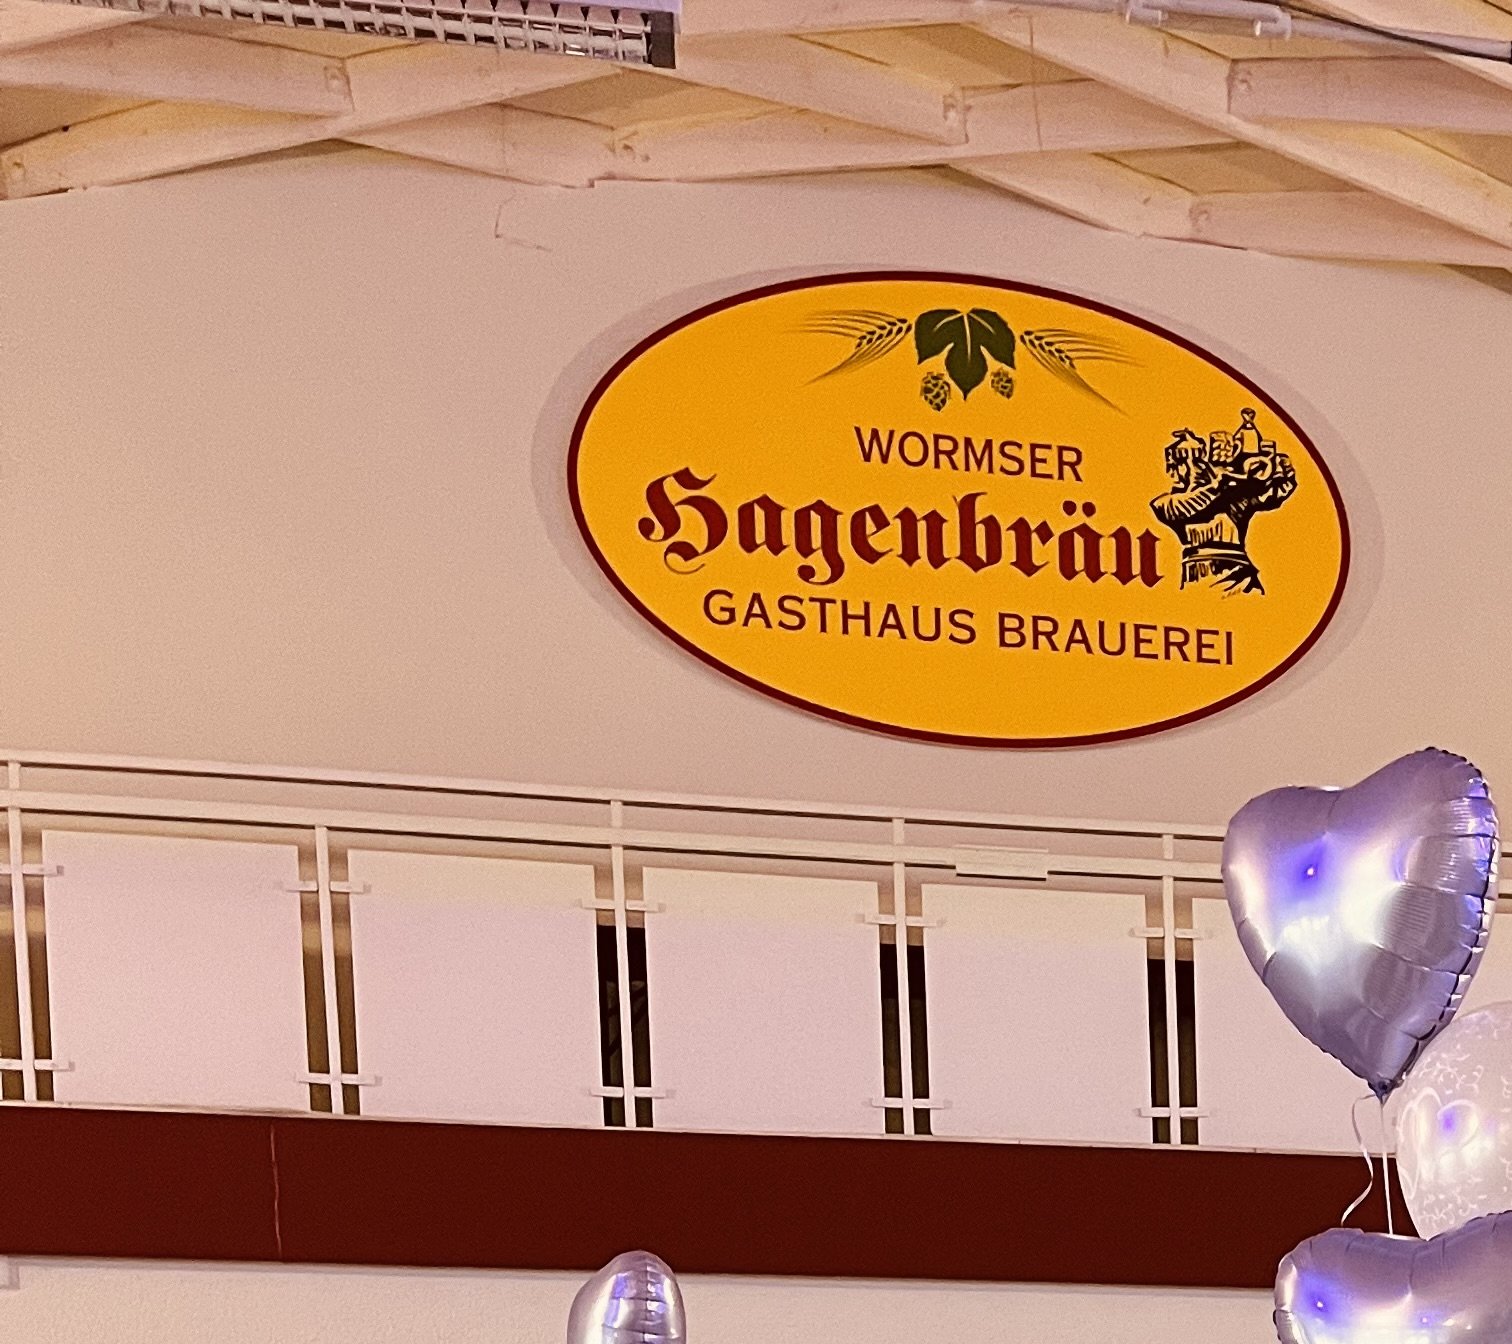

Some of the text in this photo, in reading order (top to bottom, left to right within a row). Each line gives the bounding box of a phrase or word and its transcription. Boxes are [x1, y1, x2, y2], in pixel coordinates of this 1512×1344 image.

[853, 425, 1084, 483] WORMSER
[636, 465, 1166, 589] Hagenbräu
[702, 588, 1234, 667] GASTHAUS BRAUEREI
